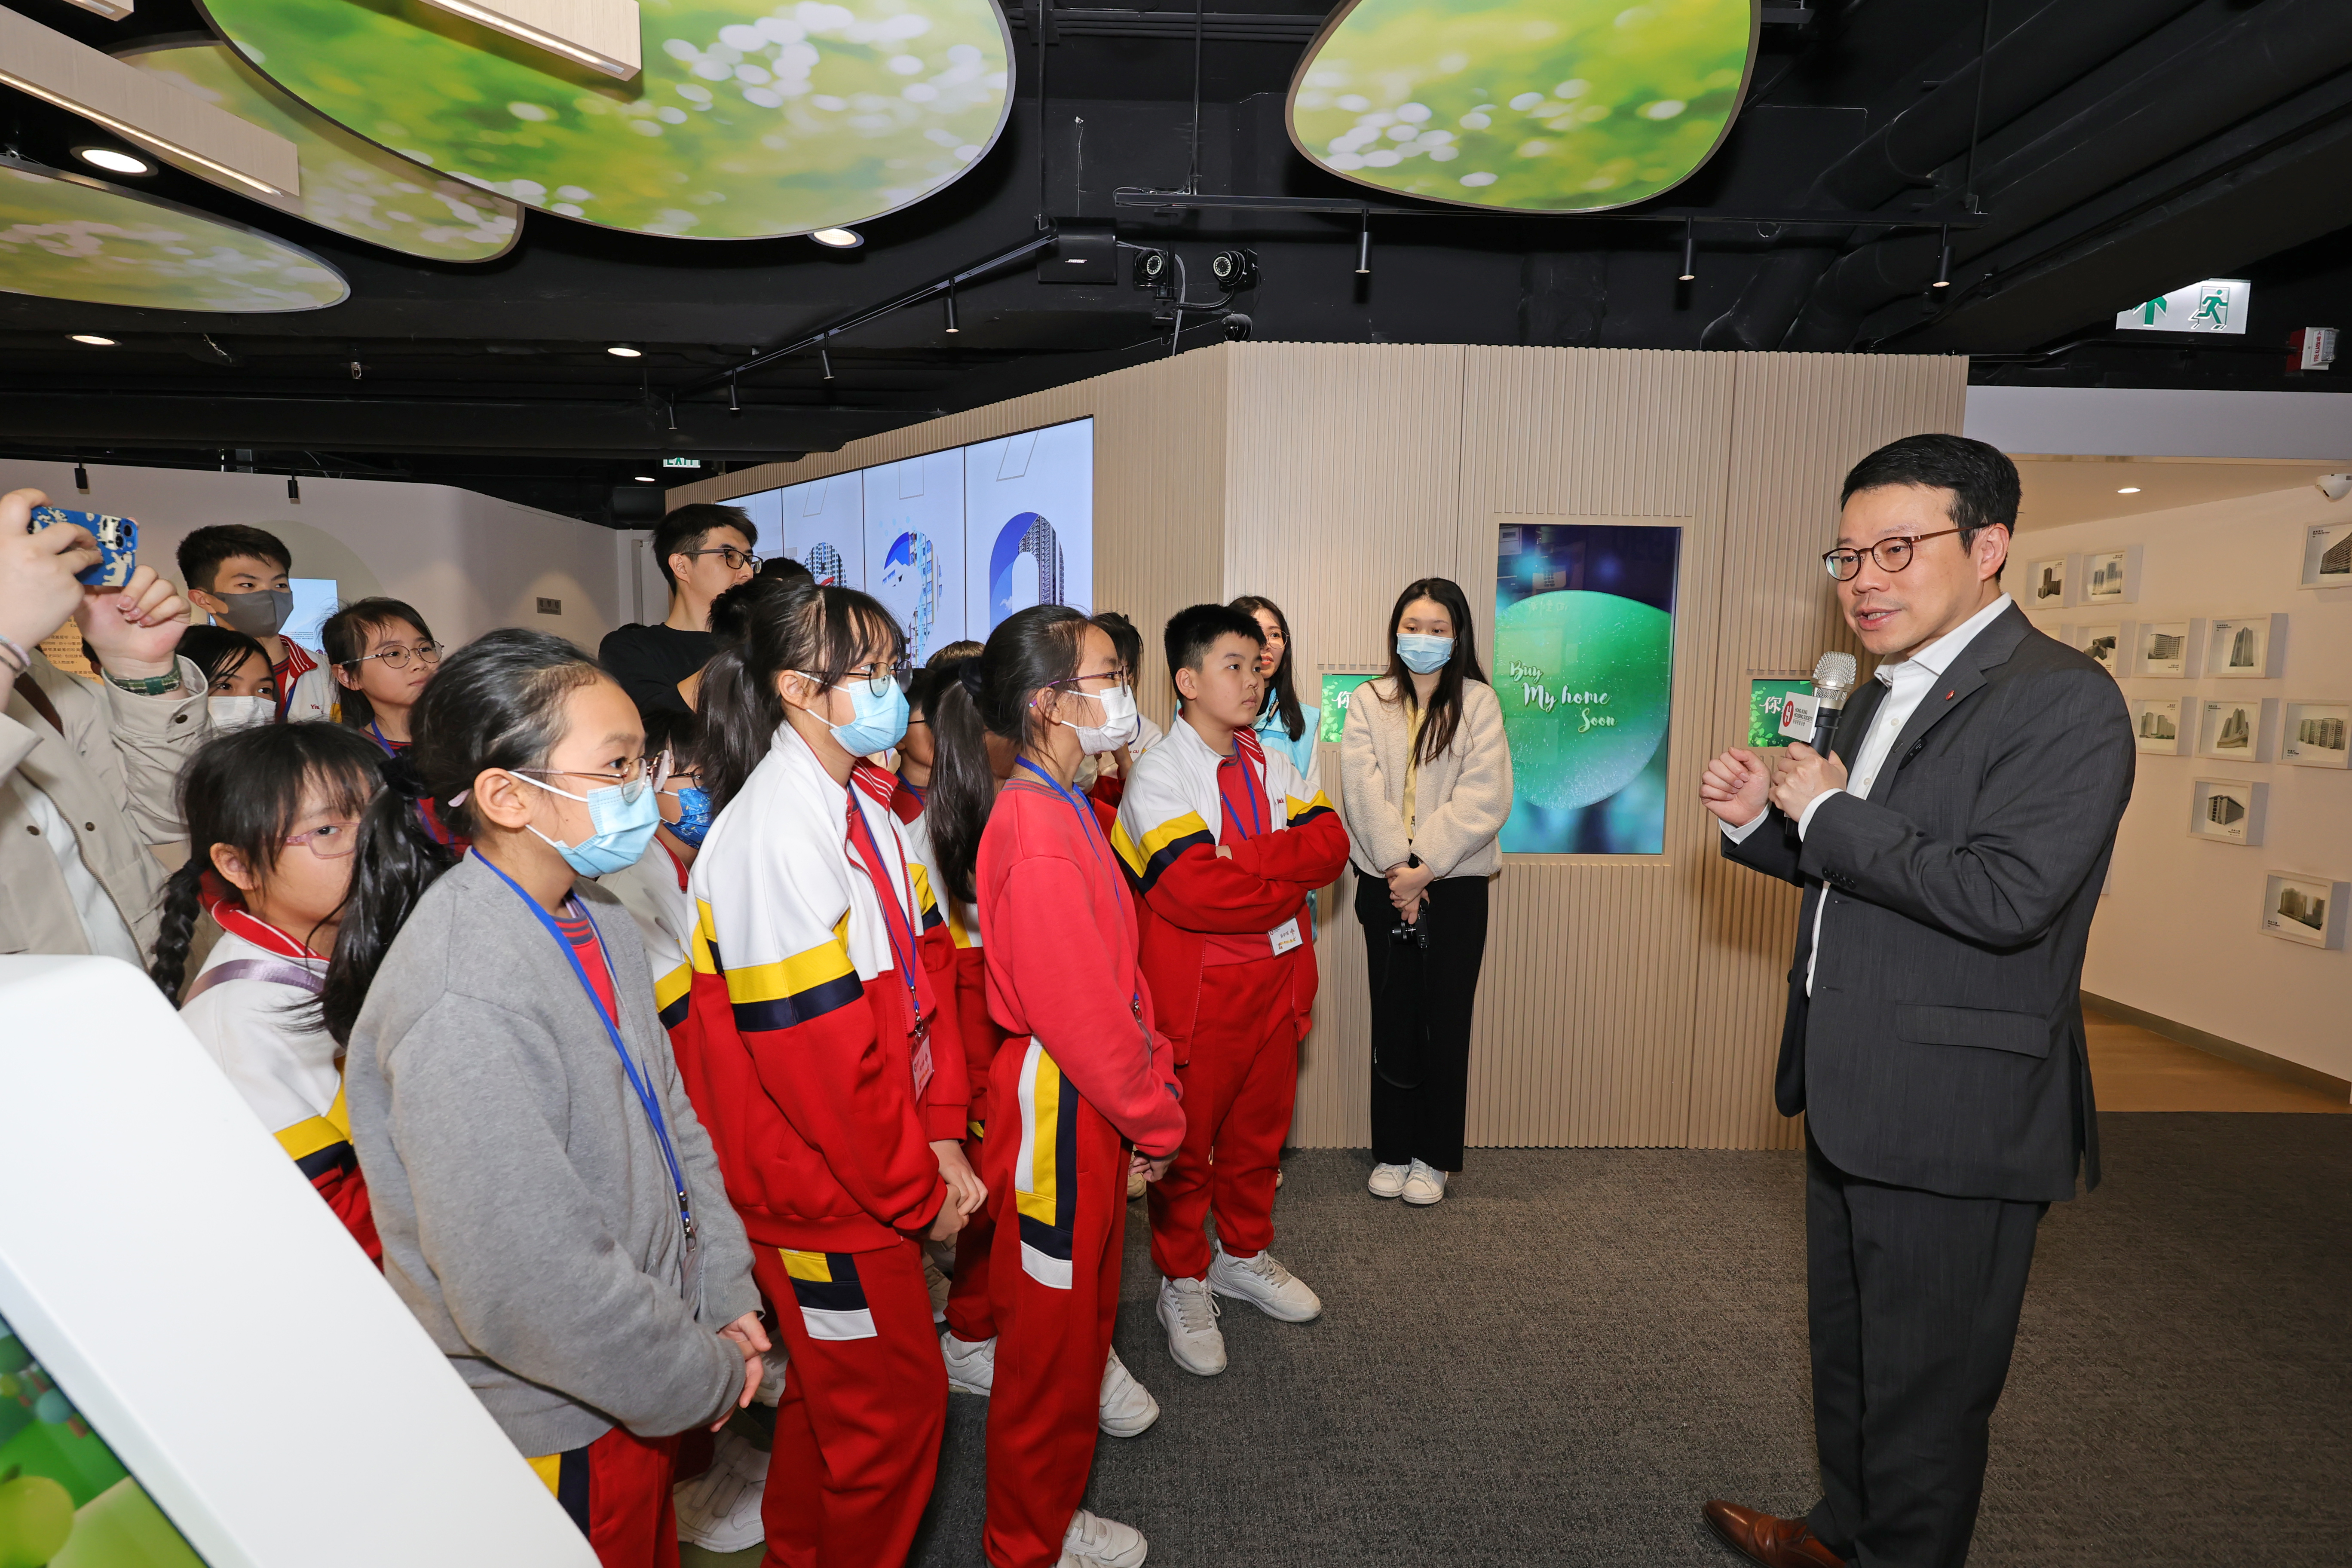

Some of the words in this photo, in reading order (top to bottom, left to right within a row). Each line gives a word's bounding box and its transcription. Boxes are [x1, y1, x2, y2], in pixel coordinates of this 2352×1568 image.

[1510, 661, 1543, 683] Buy
[1522, 682, 1557, 713] My
[1562, 685, 1611, 705] home
[1578, 708, 1617, 733] Soon
